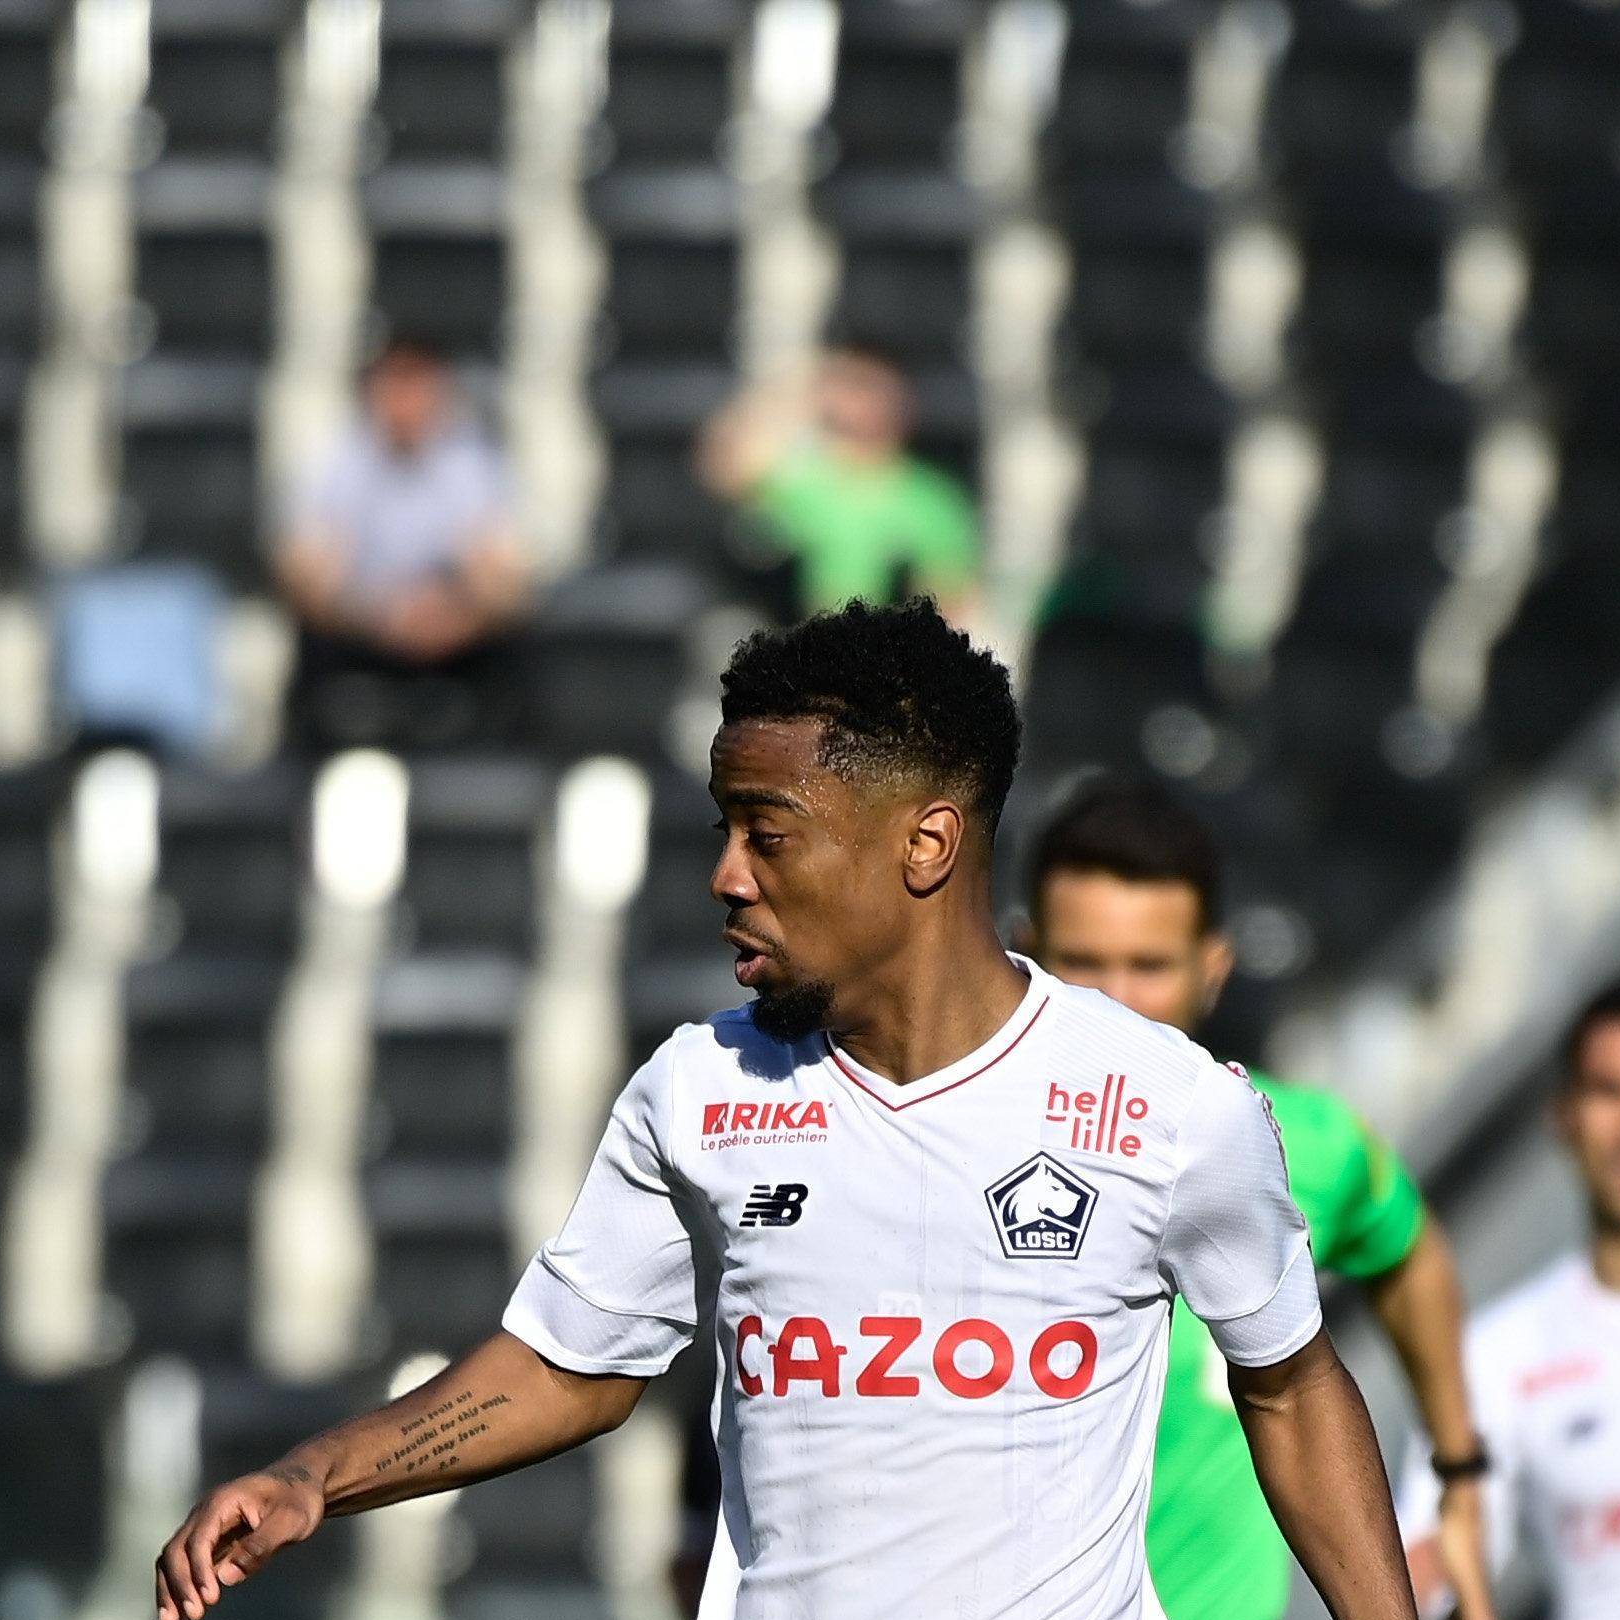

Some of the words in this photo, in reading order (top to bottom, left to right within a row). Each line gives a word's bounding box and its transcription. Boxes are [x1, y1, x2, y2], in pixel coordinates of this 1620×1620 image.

[730, 1101, 829, 1132] RIKA
[1046, 1074, 1148, 1122] hello
[701, 1139, 716, 1151] Le
[753, 1130, 828, 1145] autrichien
[1071, 1114, 1142, 1158] lille
[1015, 1231, 1071, 1249] LOSC
[736, 1314, 1099, 1400] CAZOO
